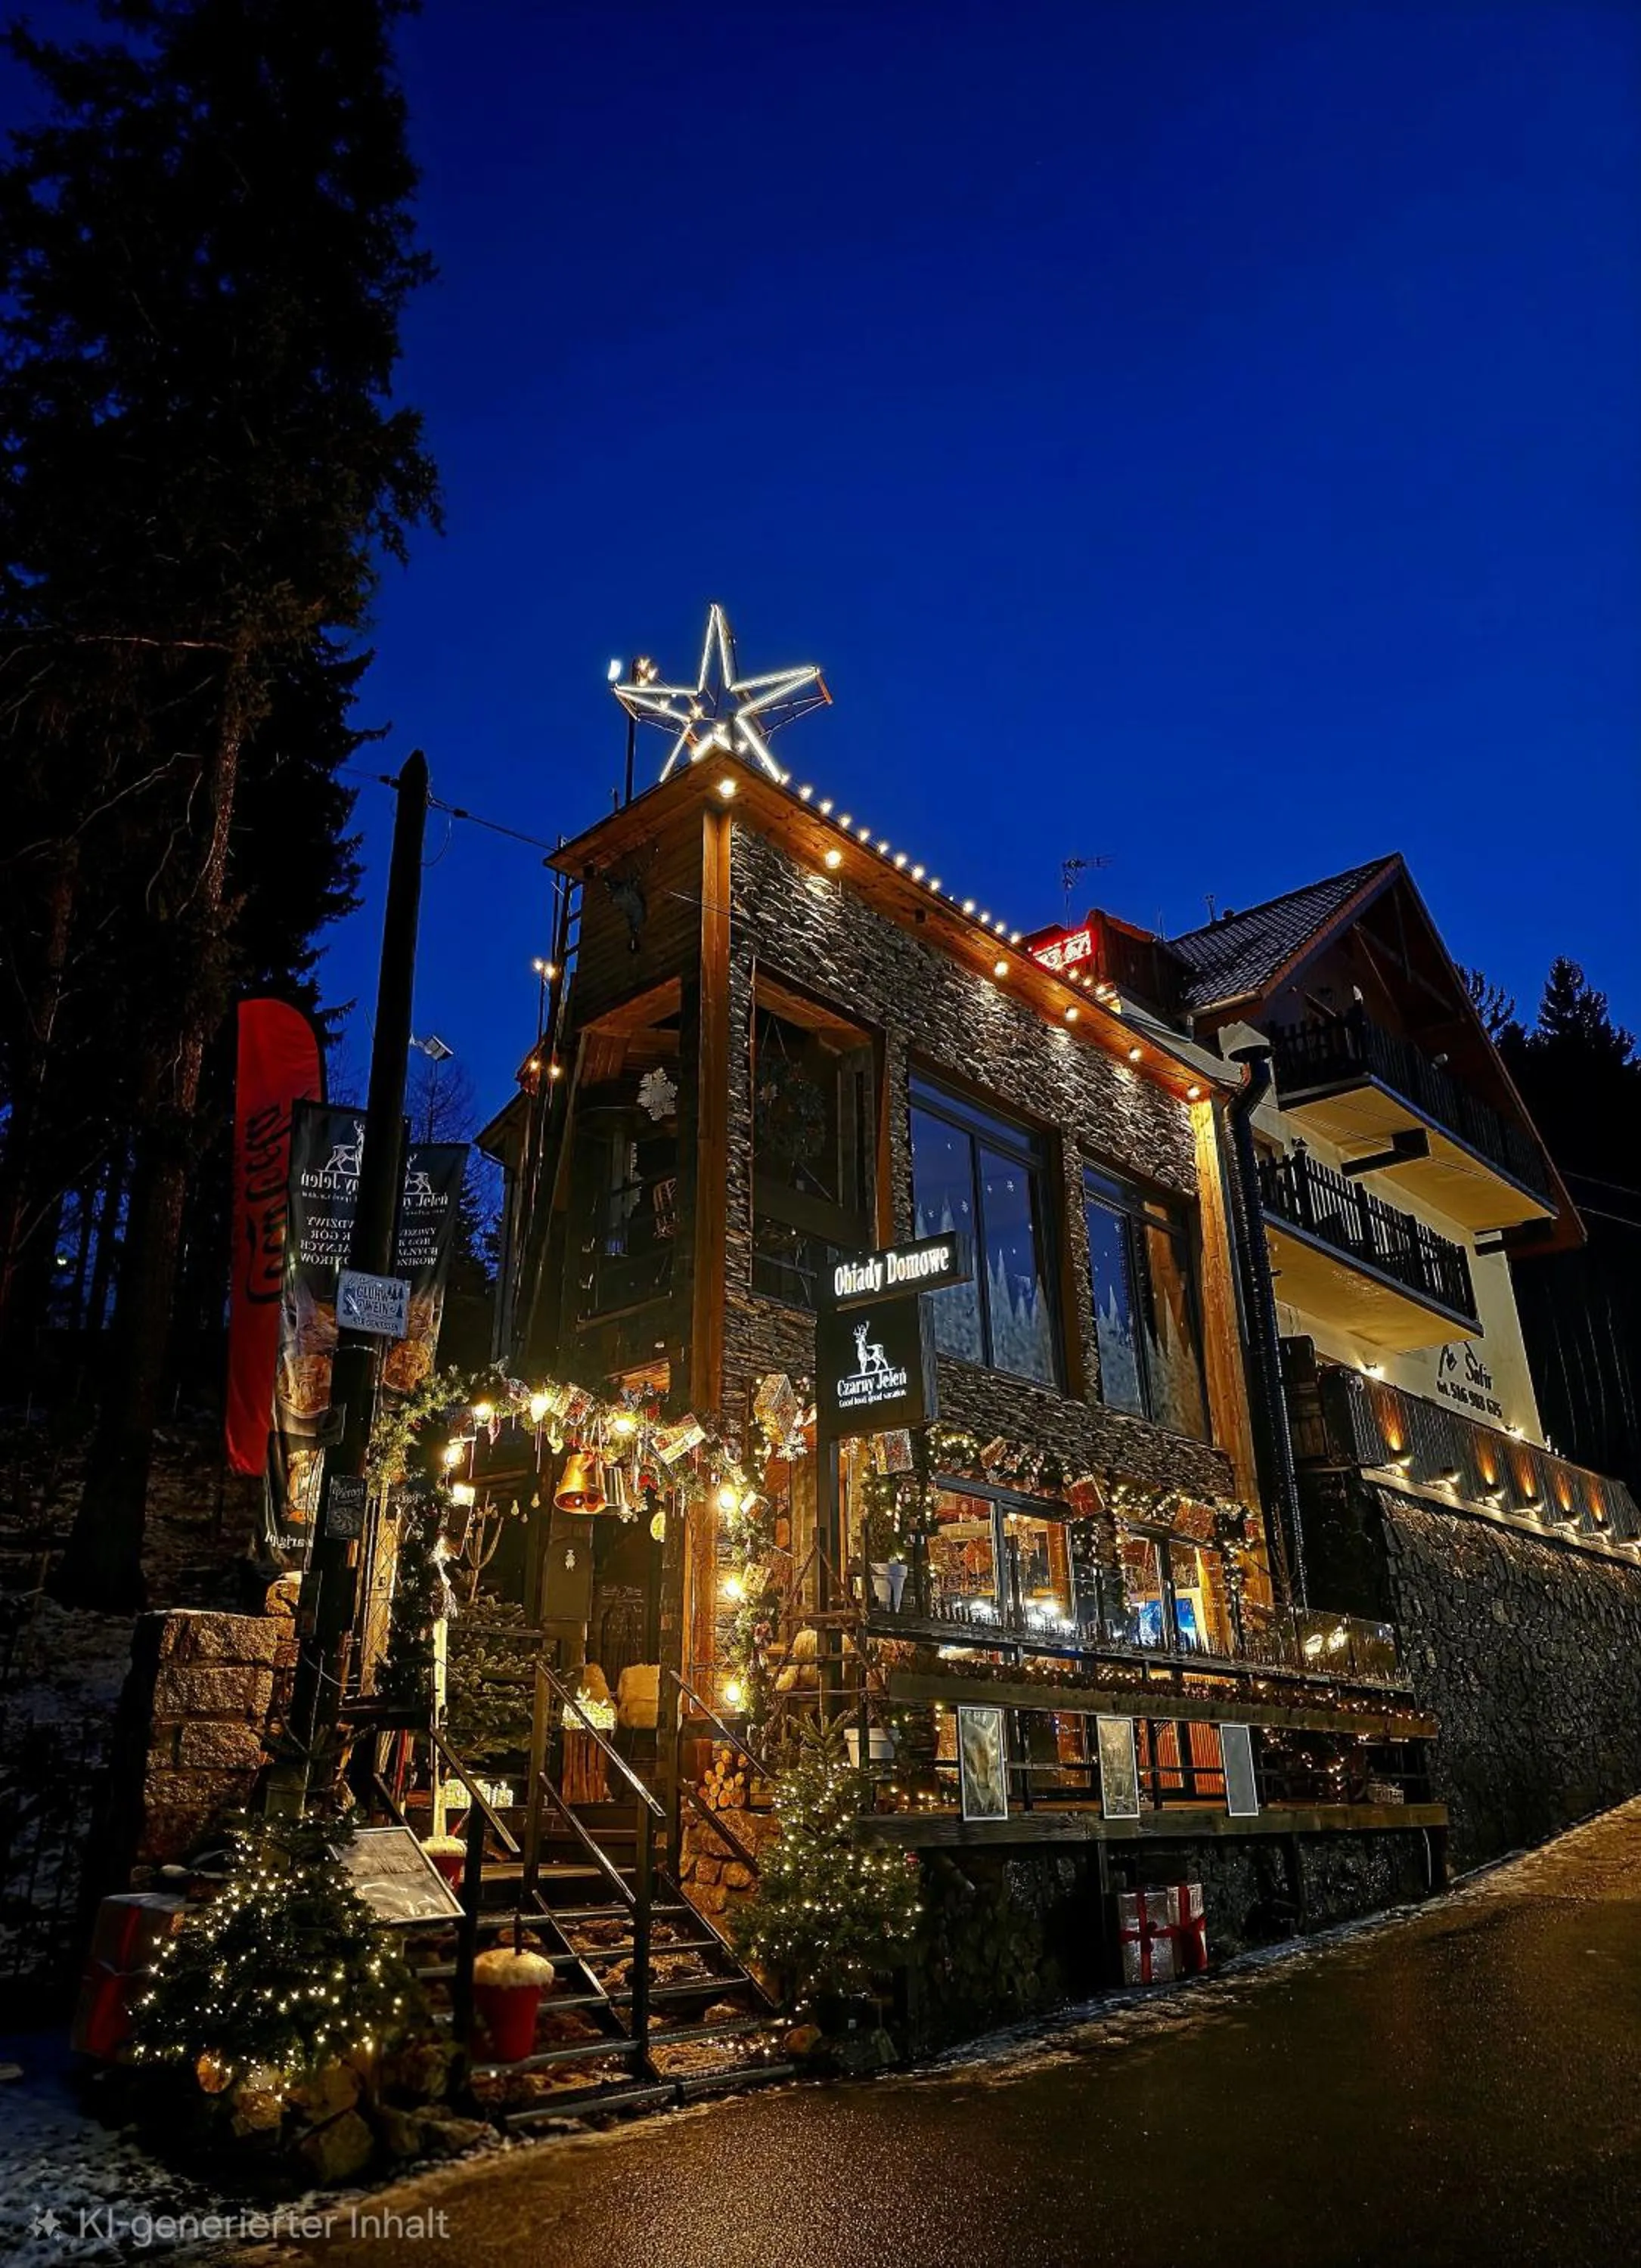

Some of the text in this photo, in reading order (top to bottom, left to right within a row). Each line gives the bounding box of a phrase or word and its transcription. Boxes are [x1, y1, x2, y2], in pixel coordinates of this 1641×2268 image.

[834, 1247, 950, 1297] Obiady Domowe
[837, 1367, 907, 1398] Czarny Jeleń
